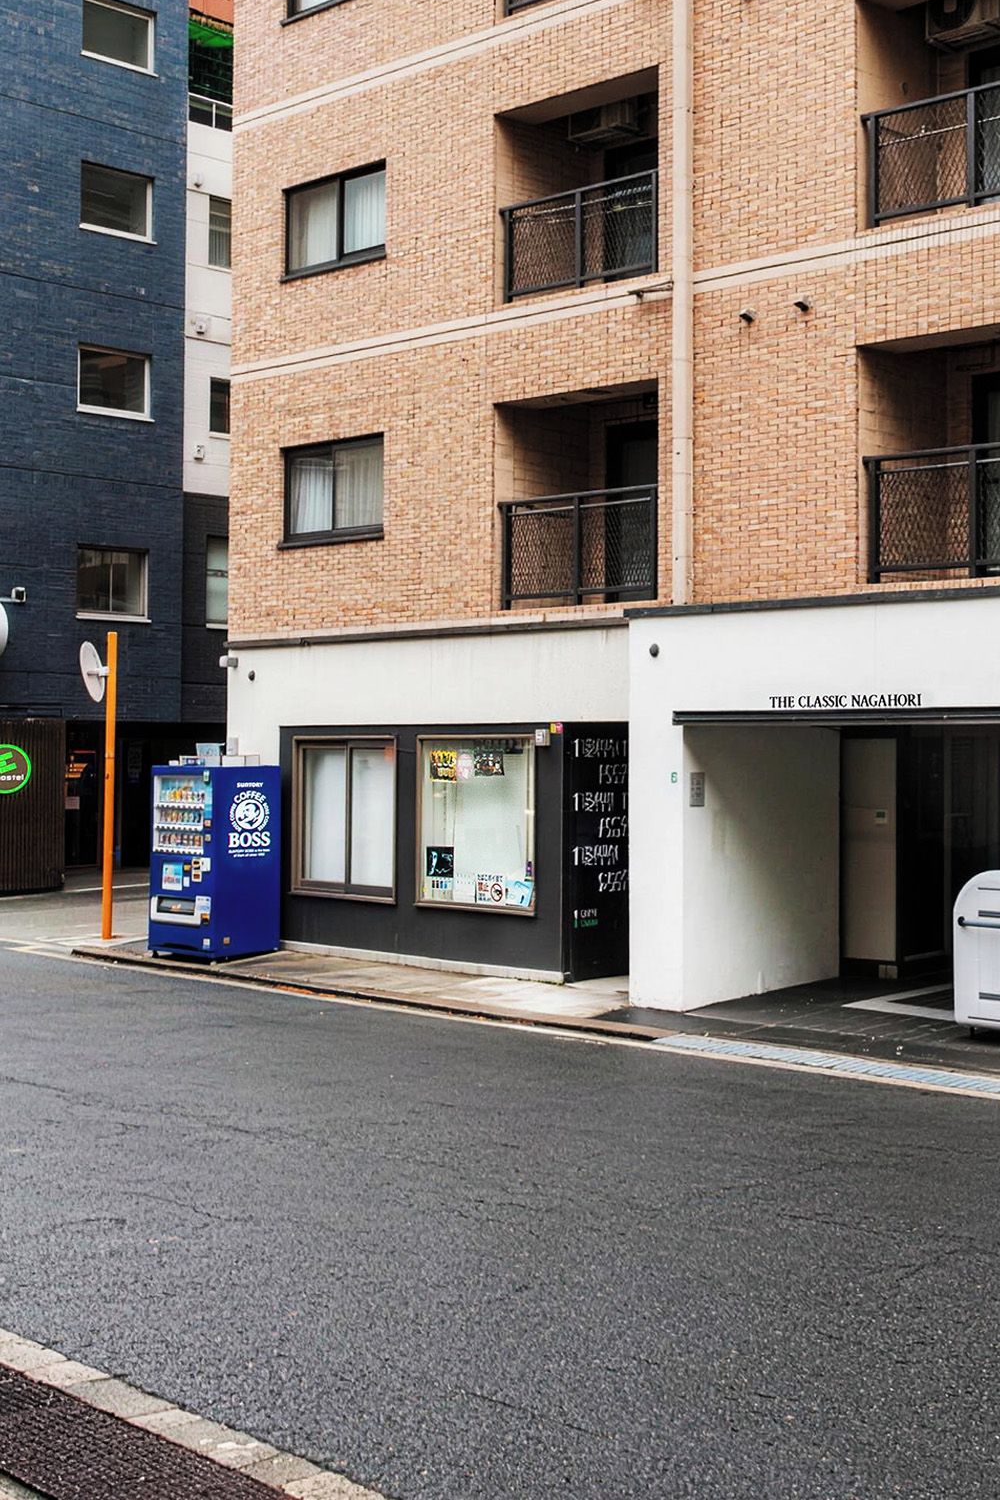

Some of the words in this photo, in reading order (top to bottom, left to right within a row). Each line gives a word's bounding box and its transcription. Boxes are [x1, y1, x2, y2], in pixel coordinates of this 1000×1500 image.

[769, 696, 795, 708] THE
[798, 694, 848, 708] CLASSIC
[851, 693, 922, 707] NAGAHORI
[233, 790, 267, 804] COFFEE
[228, 831, 271, 848] BOSS
